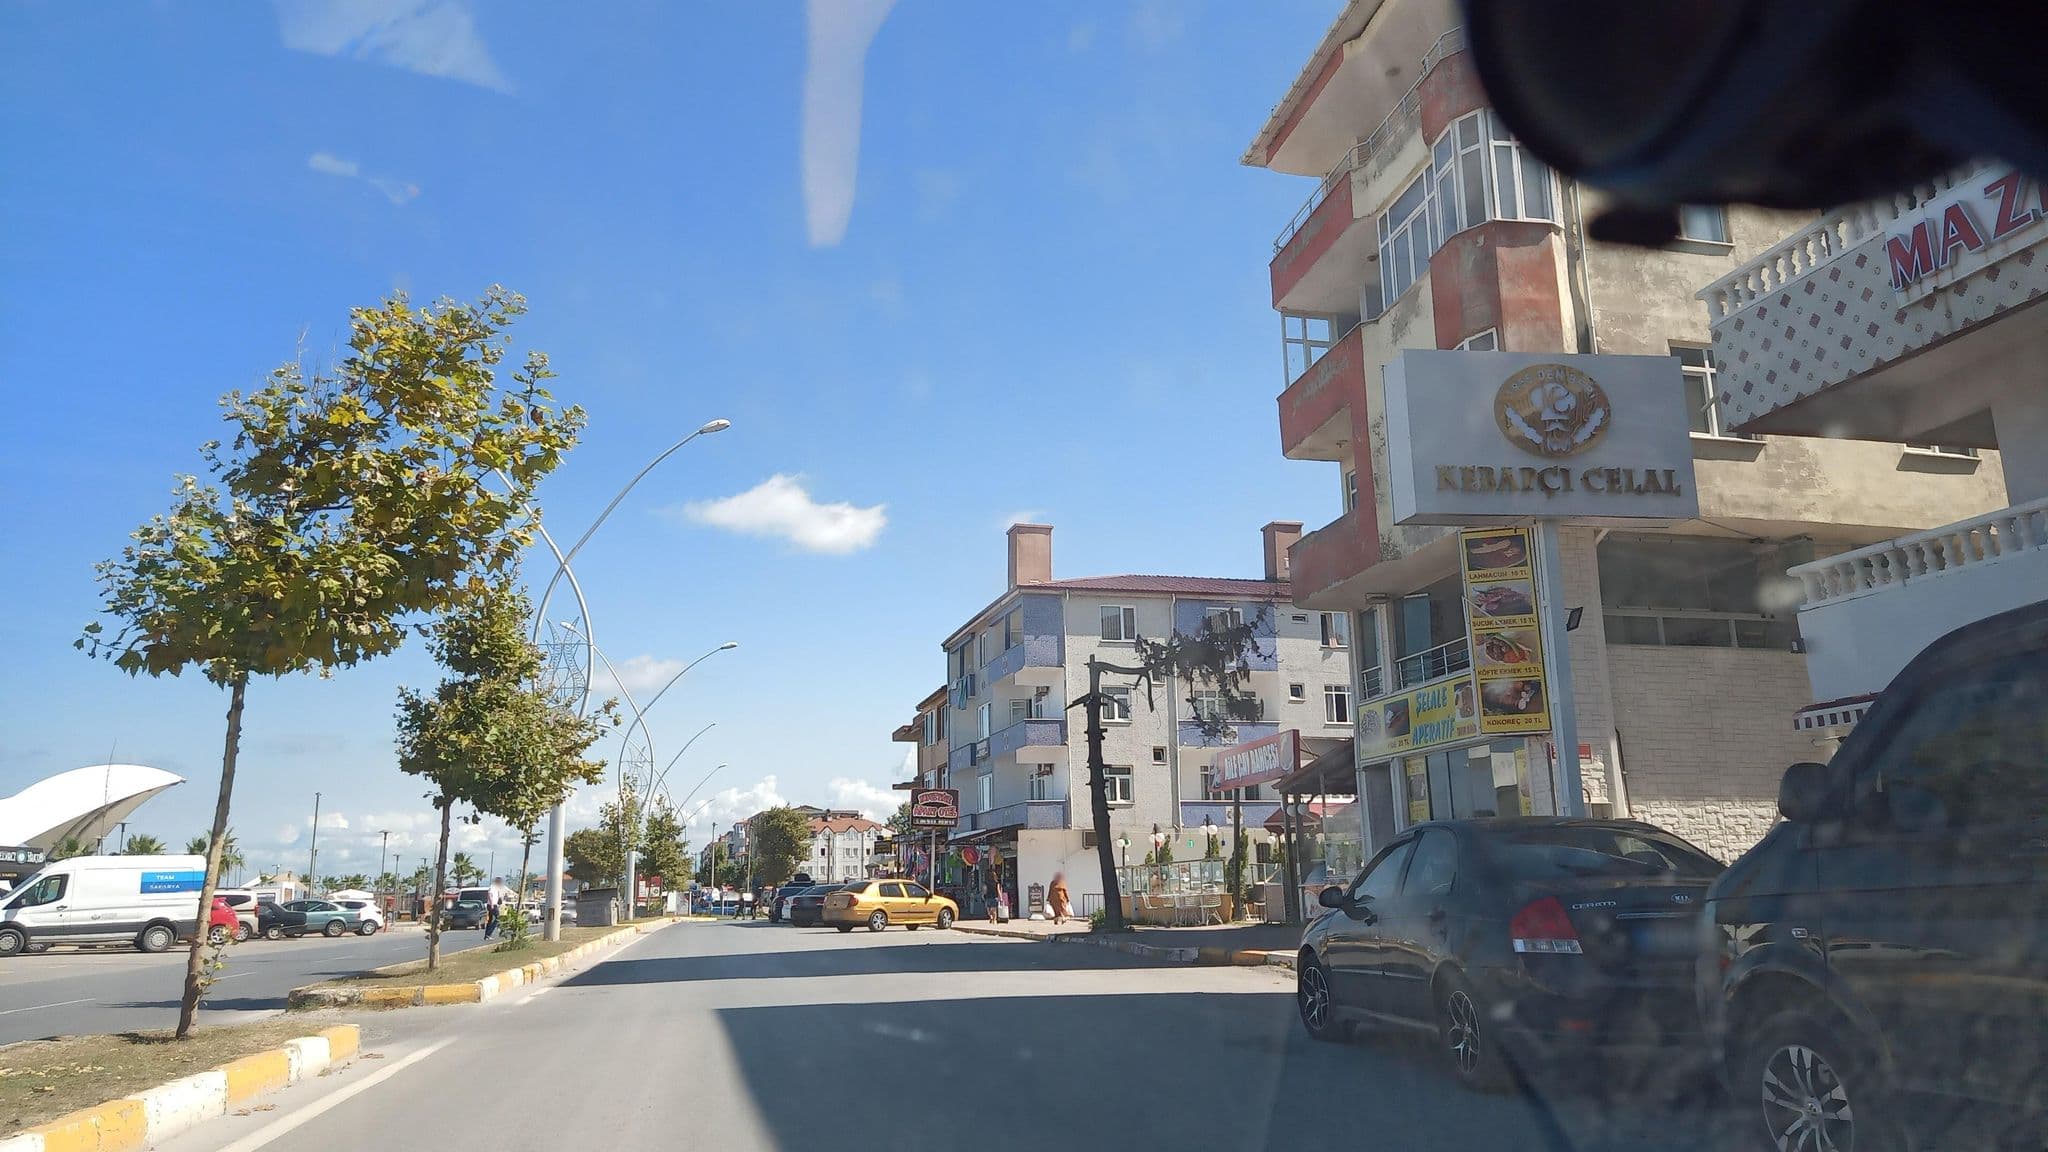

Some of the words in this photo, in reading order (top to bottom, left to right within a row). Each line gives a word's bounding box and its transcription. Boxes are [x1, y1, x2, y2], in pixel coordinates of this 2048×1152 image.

[1435, 465, 1573, 499] KEBAPÇI
[1580, 466, 1681, 497] CELAL
[1469, 570, 1508, 580] LAHMACUN
[1412, 714, 1456, 746] APERATİF
[1486, 718, 1521, 727] KOKOREÇ
